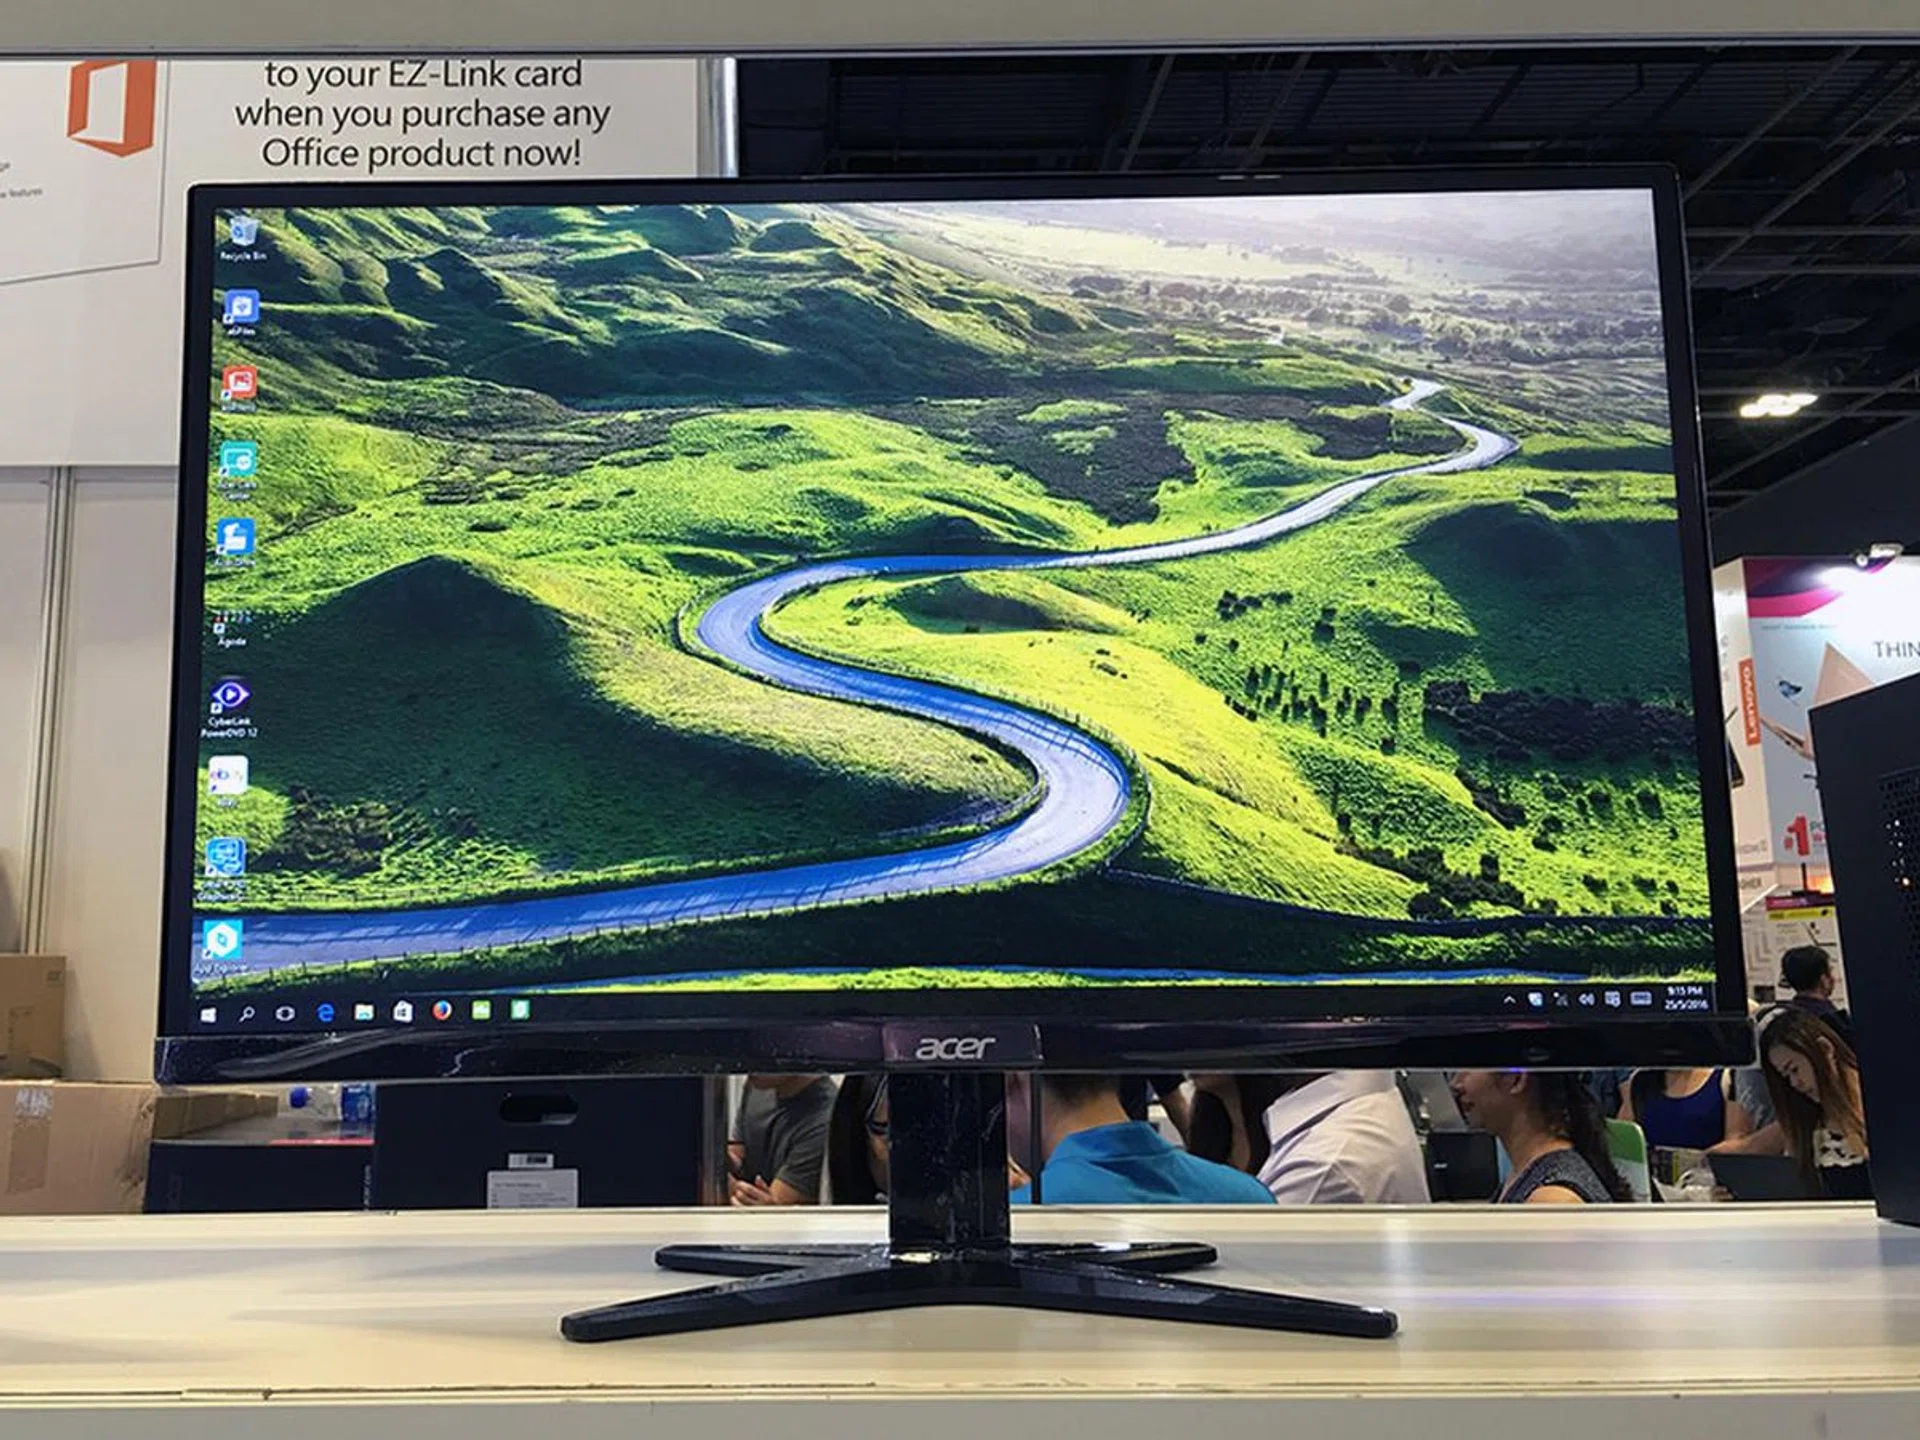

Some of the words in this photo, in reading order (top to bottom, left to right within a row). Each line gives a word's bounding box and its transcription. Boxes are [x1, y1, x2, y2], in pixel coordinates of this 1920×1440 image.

[266, 62, 297, 87] to
[307, 66, 380, 94] your
[389, 60, 505, 87] EZ-Link
[515, 60, 582, 87] card
[235, 99, 323, 127] when
[332, 105, 392, 134] you
[402, 98, 545, 134] purchase
[553, 105, 611, 134] any
[263, 138, 359, 167] Office
[368, 138, 495, 174] product
[504, 138, 581, 167] now!
[221, 251, 251, 262] Recycle
[253, 251, 267, 260] Bin
[915, 1037, 996, 1060] acer
